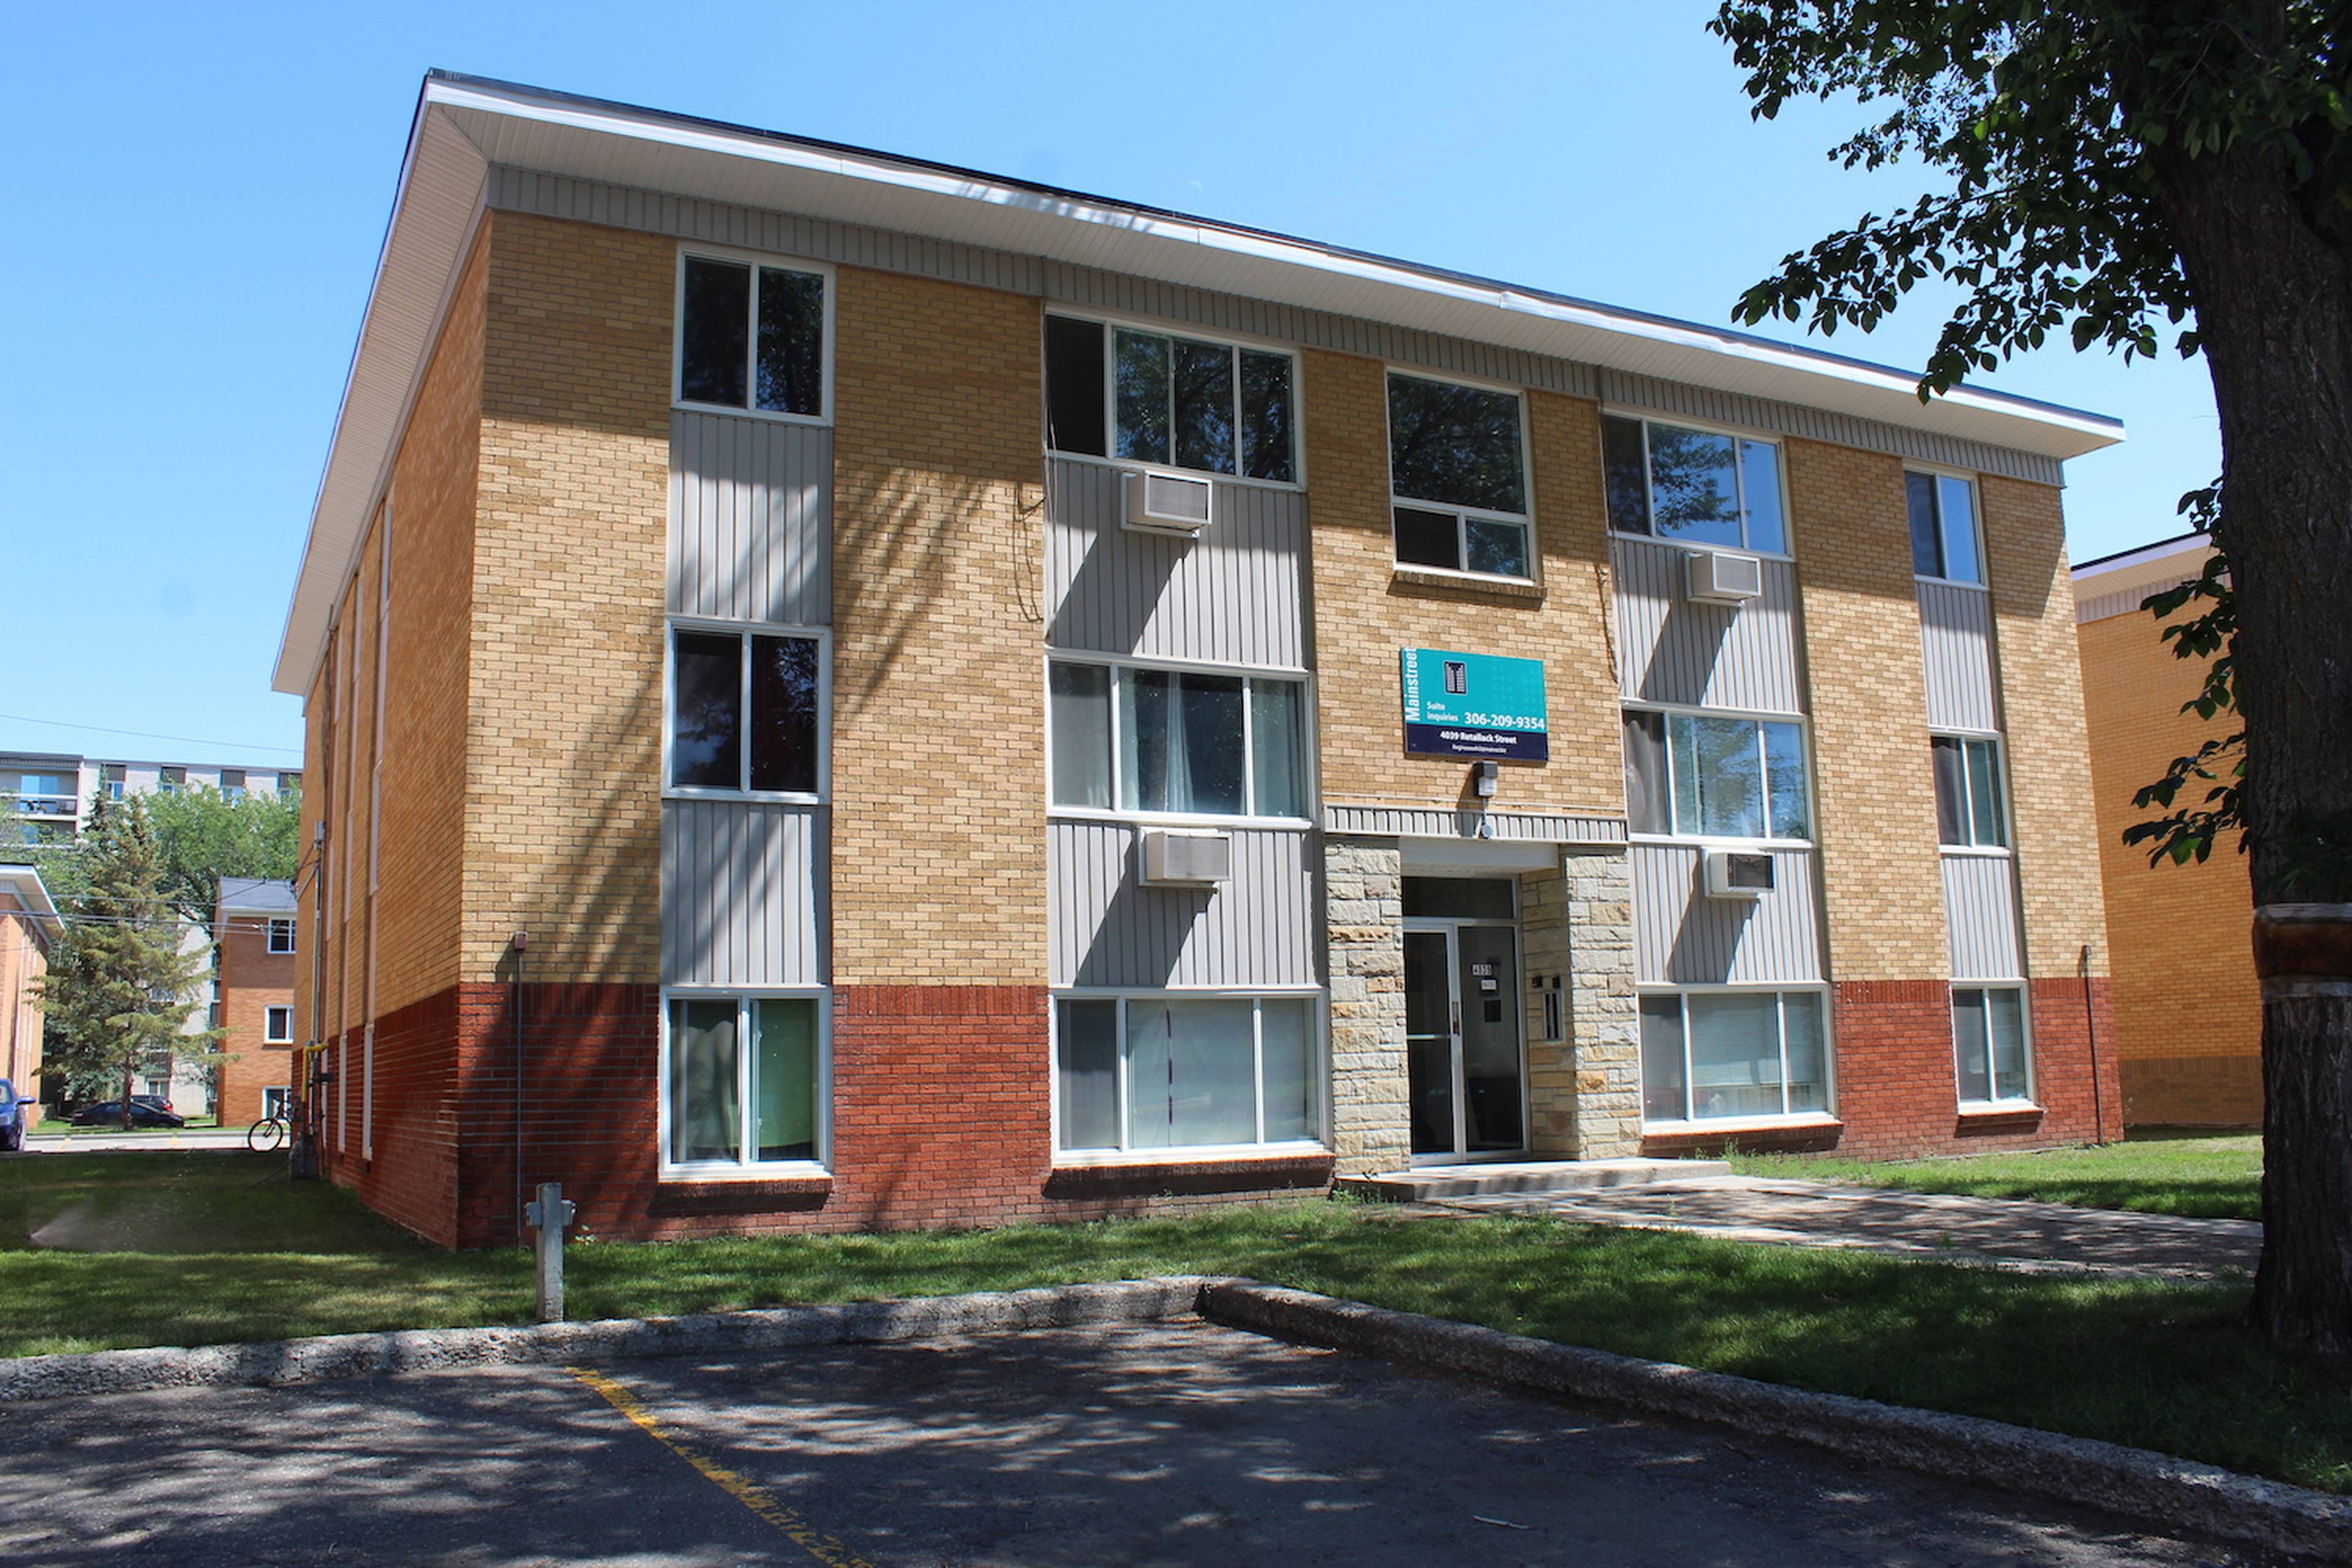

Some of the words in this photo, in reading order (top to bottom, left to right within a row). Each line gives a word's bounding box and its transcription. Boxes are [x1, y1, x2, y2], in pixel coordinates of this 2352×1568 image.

[1404, 647, 1420, 721] Mainstreet
[1427, 701, 1446, 710] Suite
[1464, 712, 1545, 729] 306-209-9354
[1494, 734, 1517, 744] Street
